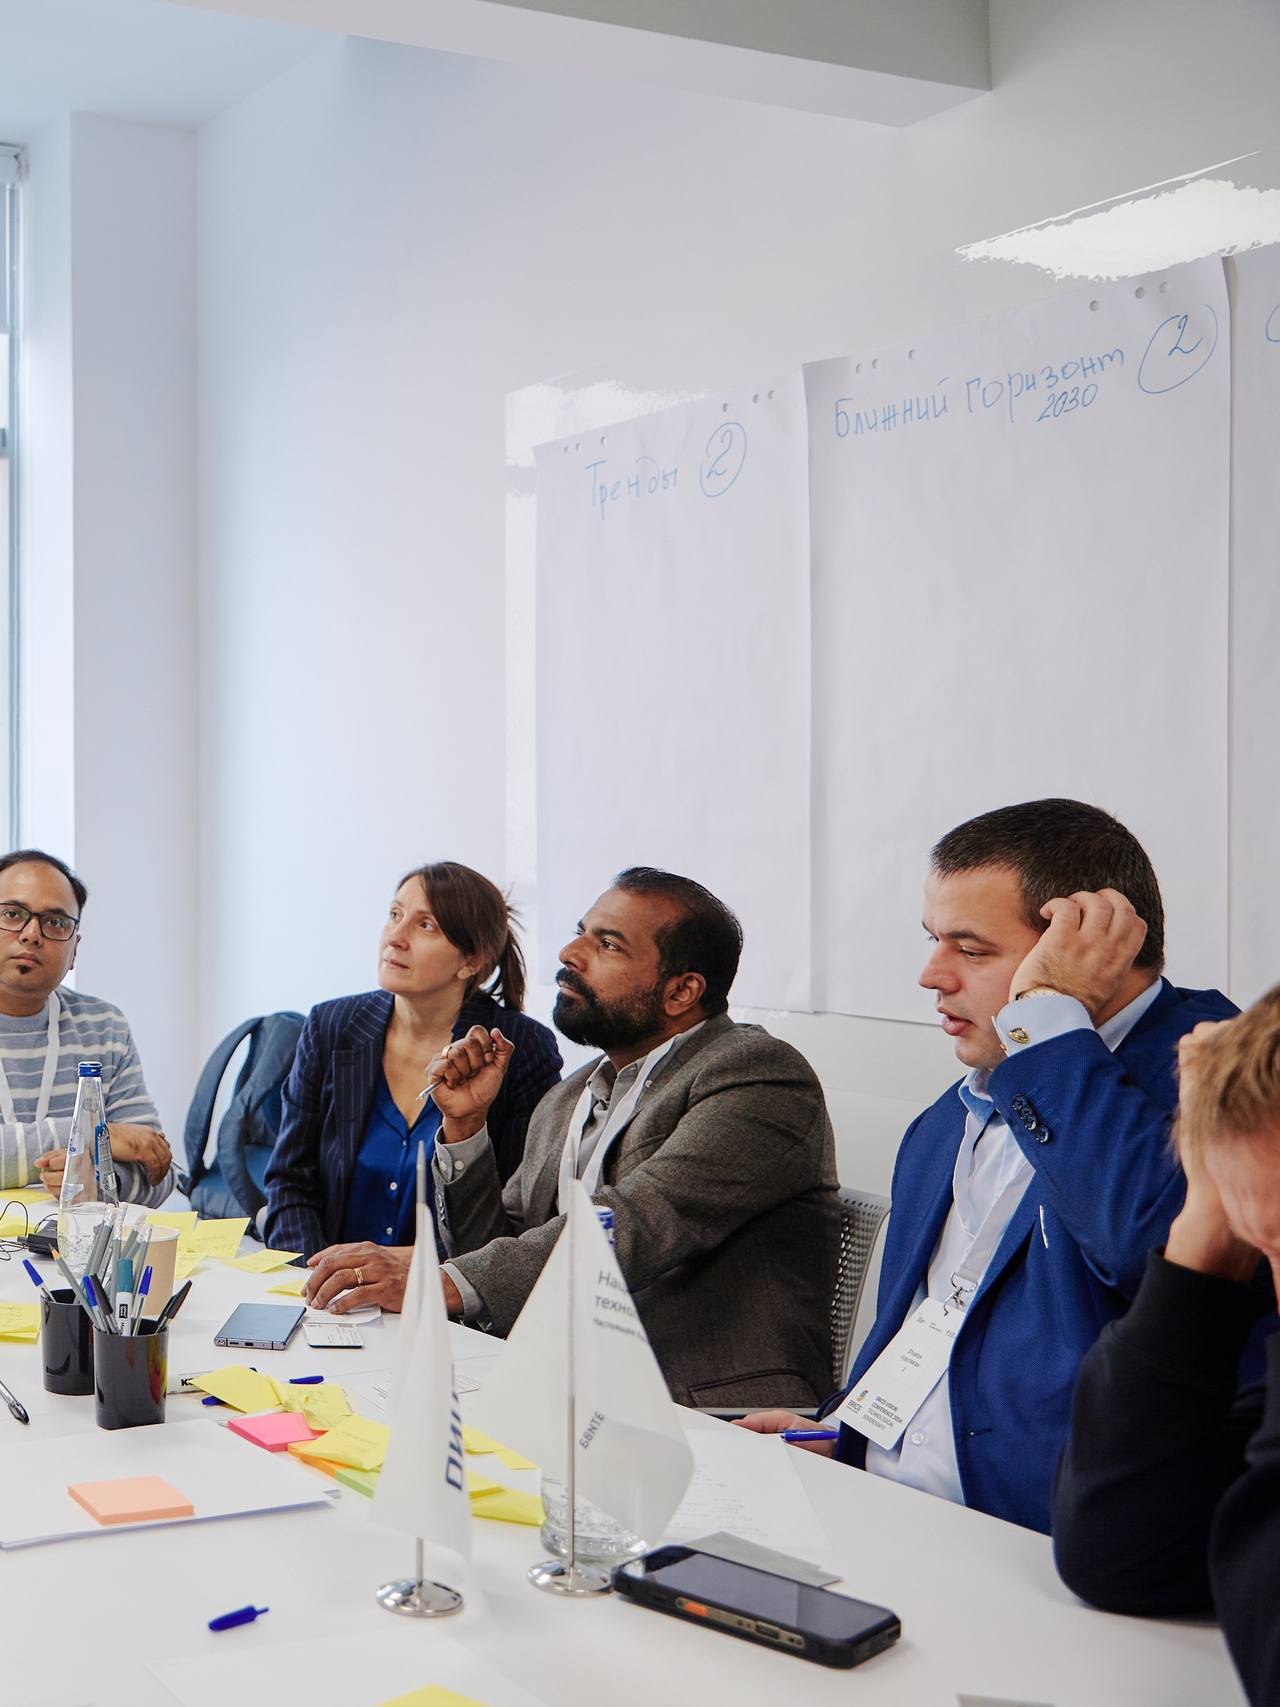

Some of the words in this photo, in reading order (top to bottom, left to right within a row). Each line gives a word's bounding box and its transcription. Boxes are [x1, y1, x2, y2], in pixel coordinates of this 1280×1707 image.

[835, 377, 950, 438] Ближний
[1036, 383, 1099, 423] 2030
[584, 456, 678, 521] Тренды
[848, 1400, 862, 1411] BRICS
[871, 1402, 894, 1417] CONFERENCE
[876, 1396, 886, 1404] BRICS
[886, 1402, 898, 1411] VISION
